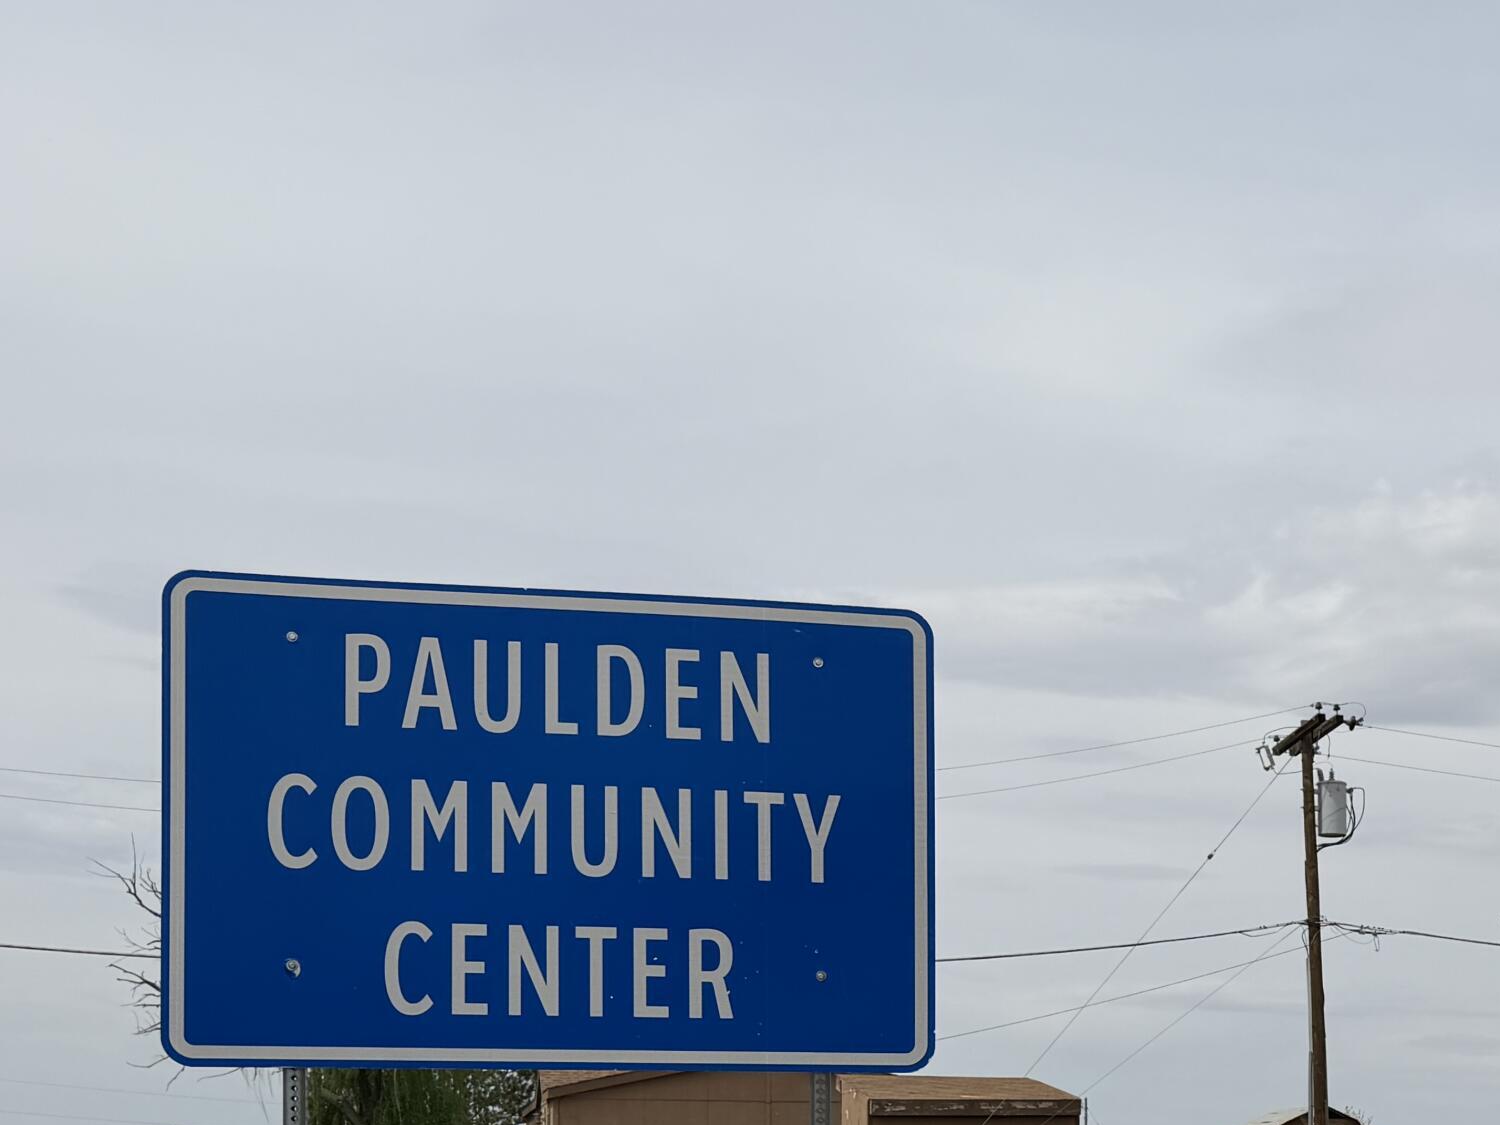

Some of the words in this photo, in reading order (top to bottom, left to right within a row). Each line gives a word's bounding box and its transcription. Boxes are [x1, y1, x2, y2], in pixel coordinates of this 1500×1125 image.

[344, 632, 771, 744] PAULDEN
[267, 773, 841, 884] COMMUNITY
[384, 920, 734, 1019] CENTER
